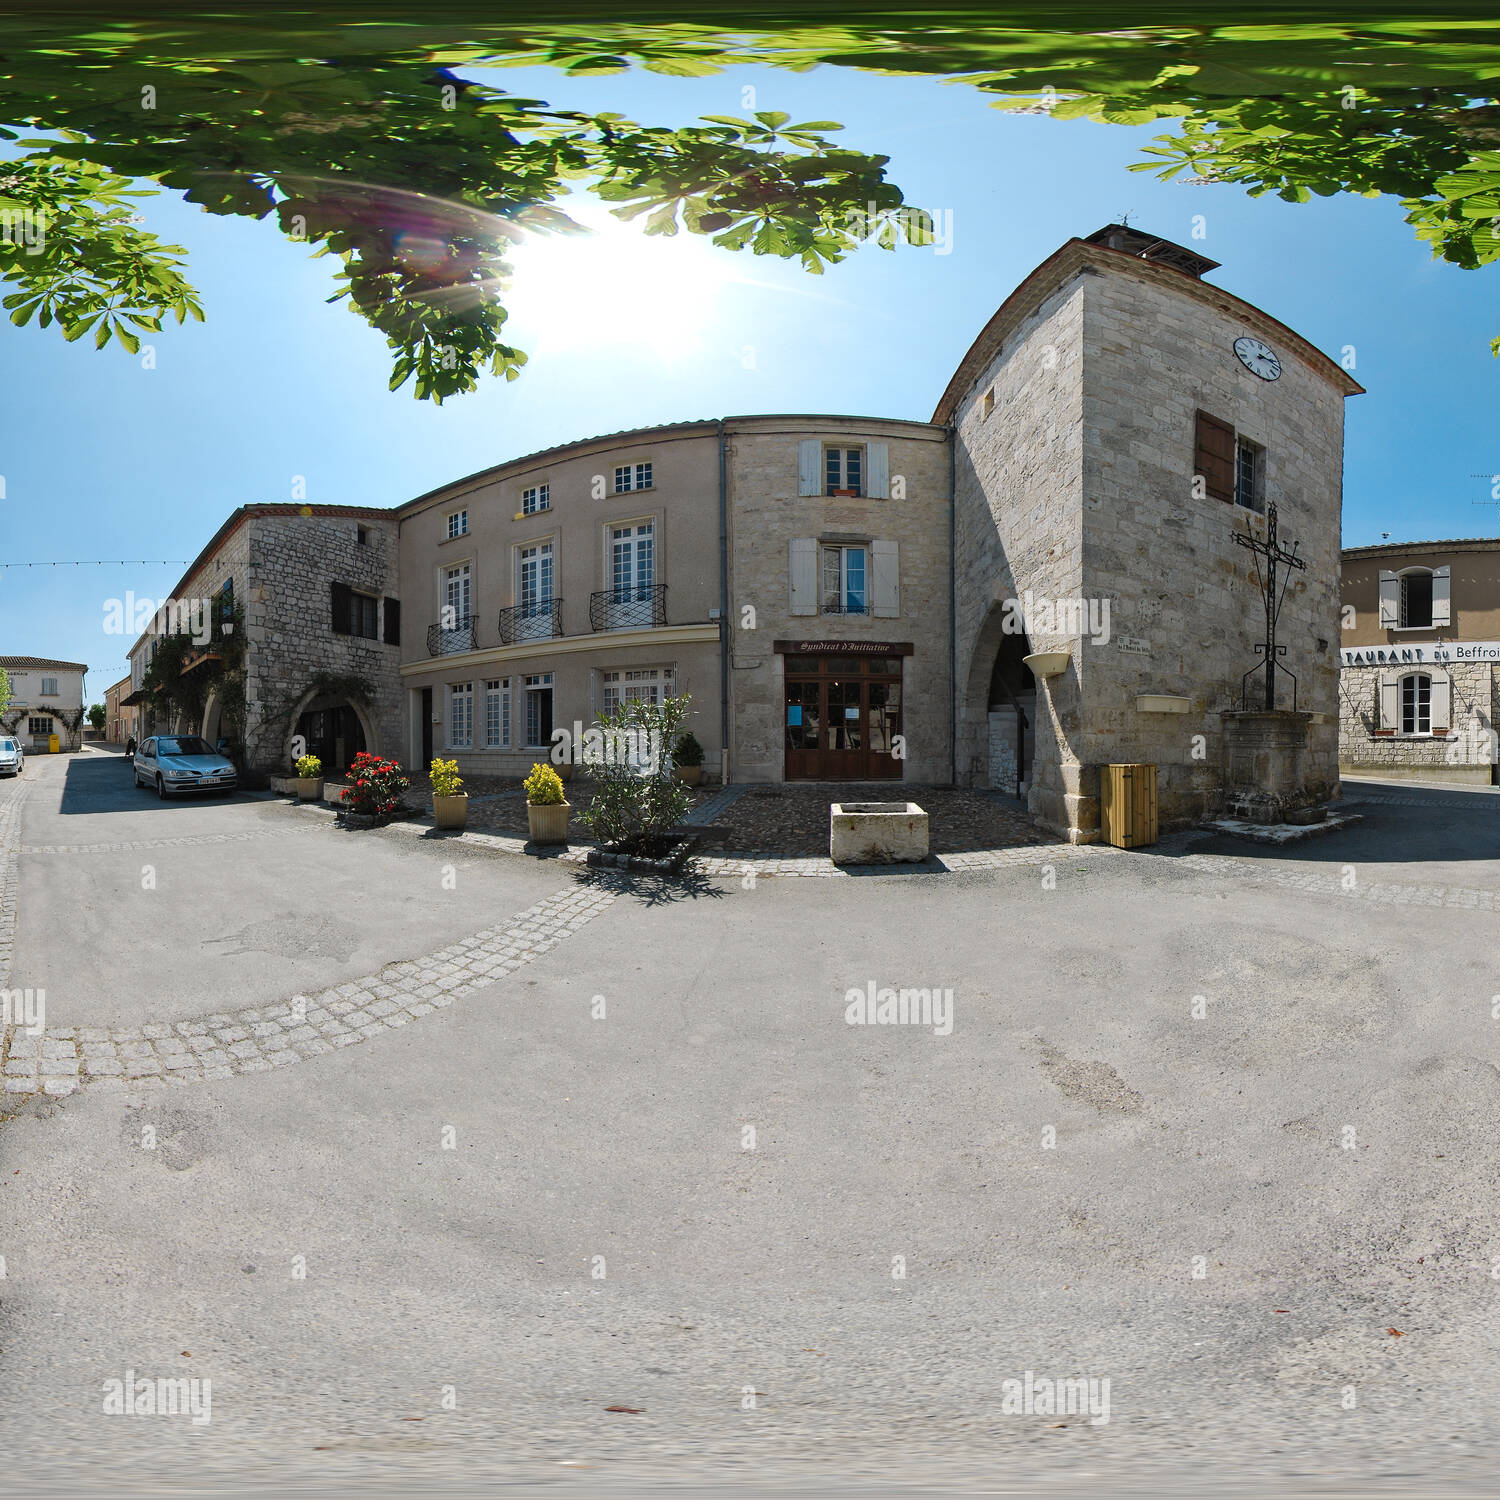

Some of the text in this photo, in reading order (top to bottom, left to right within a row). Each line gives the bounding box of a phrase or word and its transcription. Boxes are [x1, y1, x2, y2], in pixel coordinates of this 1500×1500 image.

[801, 642, 840, 652] Syndicat
[1346, 646, 1500, 662] TAURANT DU Beffroi
